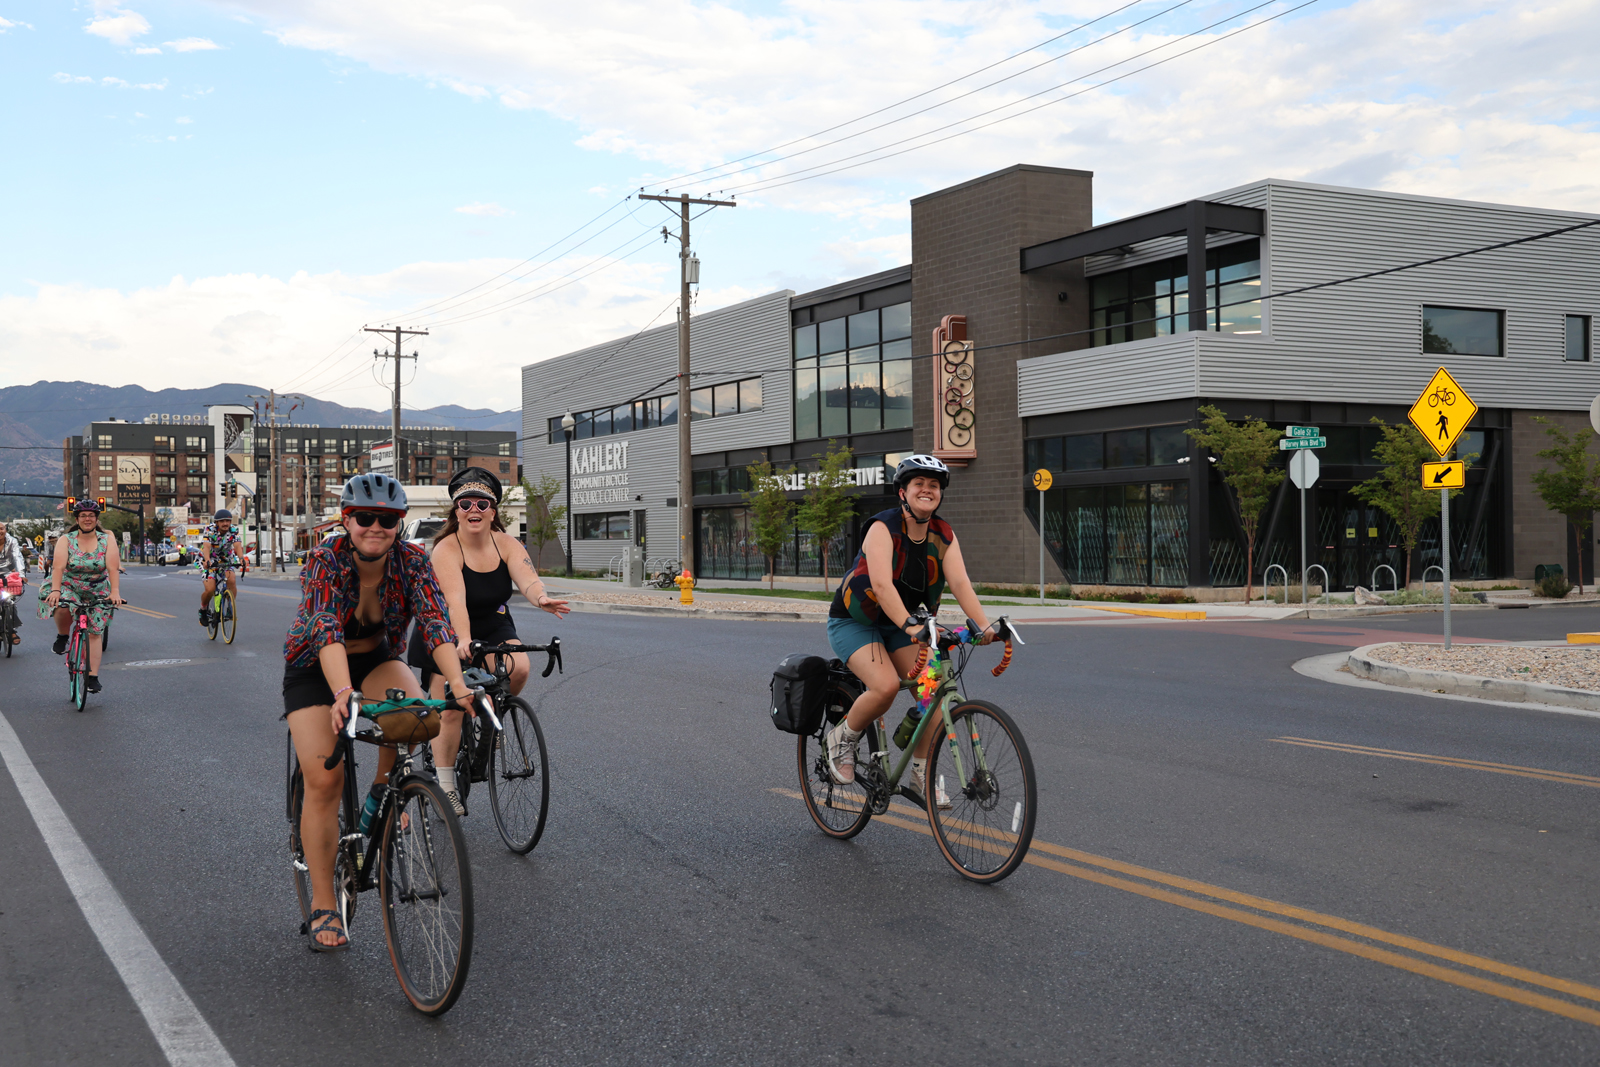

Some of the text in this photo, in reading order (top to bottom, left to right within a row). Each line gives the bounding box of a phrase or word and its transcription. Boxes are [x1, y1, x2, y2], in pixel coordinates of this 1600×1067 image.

[1293, 428, 1305, 436] Gale
[1306, 428, 1312, 436] St
[382, 451, 393, 459] TIRES
[572, 441, 629, 475] KAHLERT
[572, 473, 629, 490] COMMUNITY BICYCLE
[758, 466, 885, 492] YCLE COECTIVE
[1033, 472, 1042, 487] 9
[572, 488, 629, 505] RESOURCE CENTER
